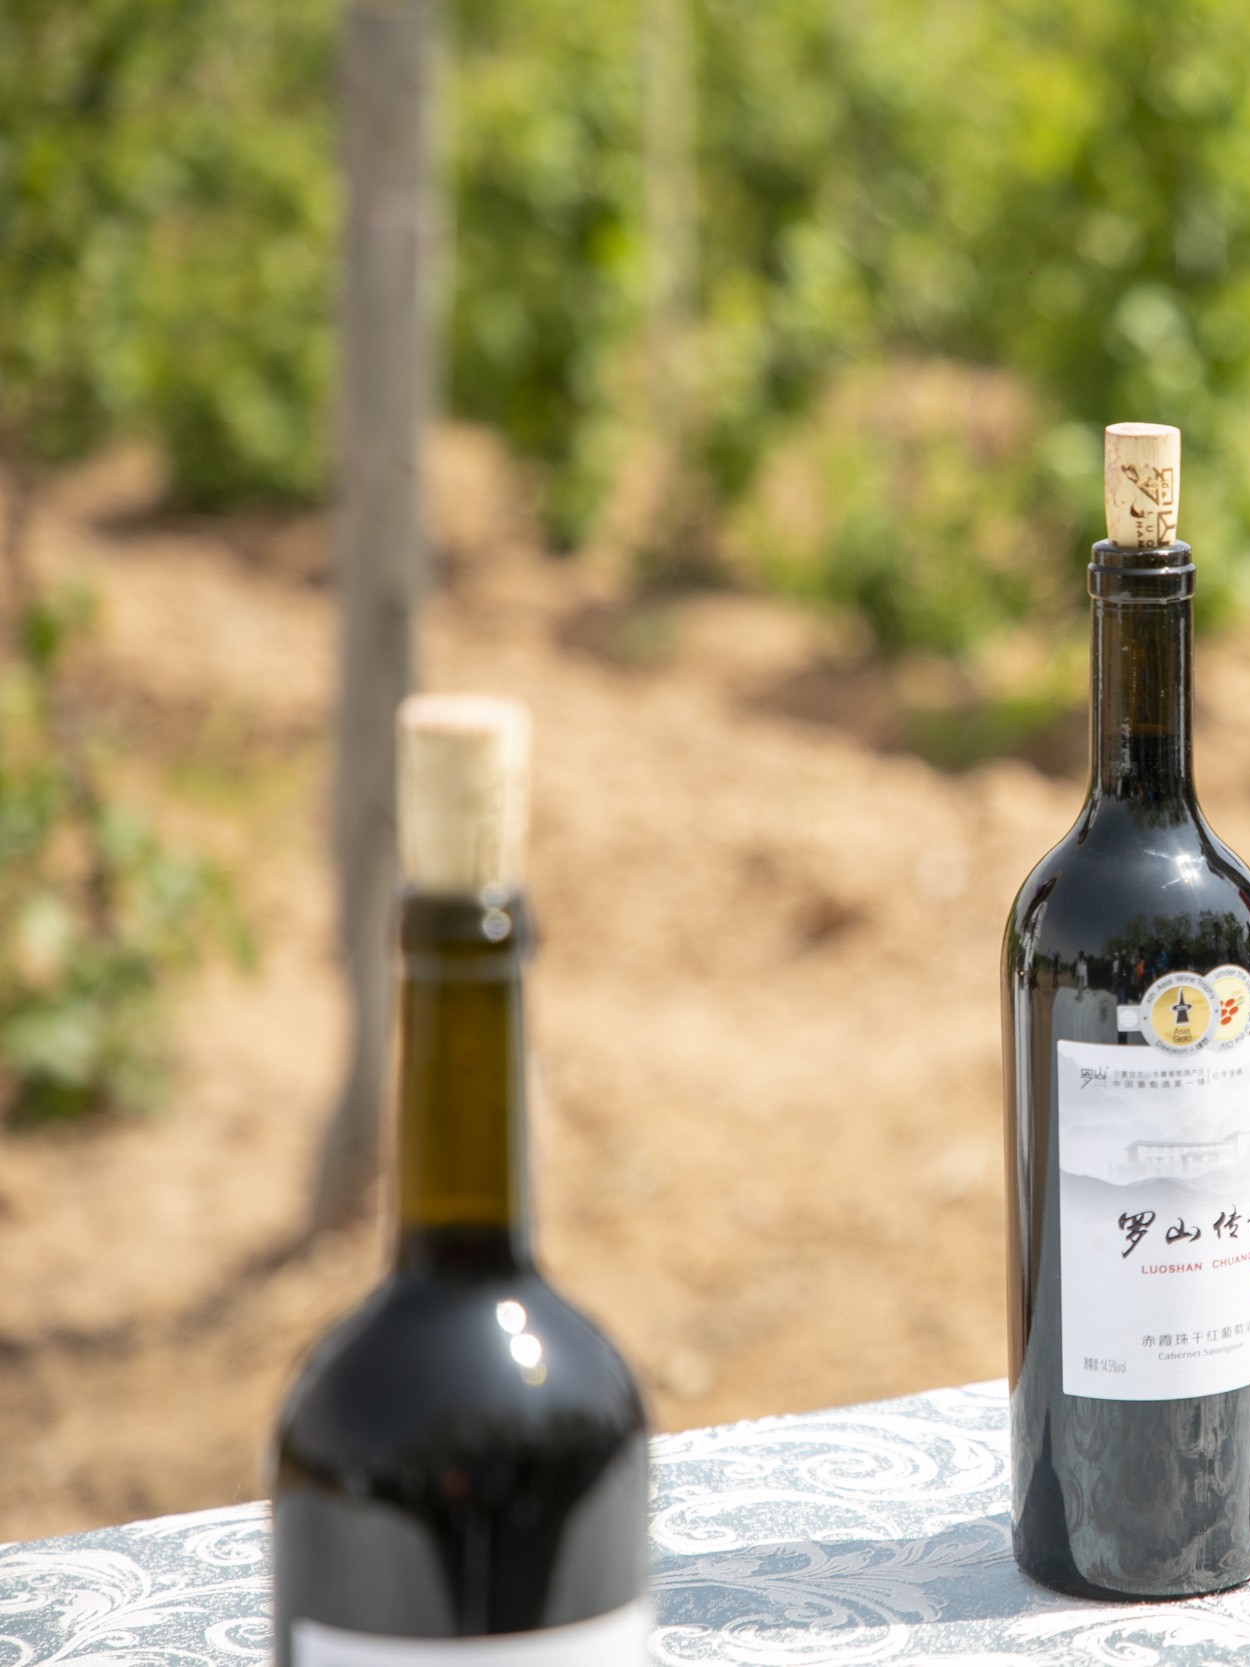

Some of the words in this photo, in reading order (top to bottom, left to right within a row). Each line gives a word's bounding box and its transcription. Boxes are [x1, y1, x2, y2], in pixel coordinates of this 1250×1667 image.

[1175, 975, 1197, 985] Wine
[1196, 978, 1217, 1001] Trophy
[1141, 1262, 1203, 1275] LUOSHAN
[1157, 1350, 1201, 1361] Cabernet
[1203, 1341, 1244, 1357] Sauvignon
